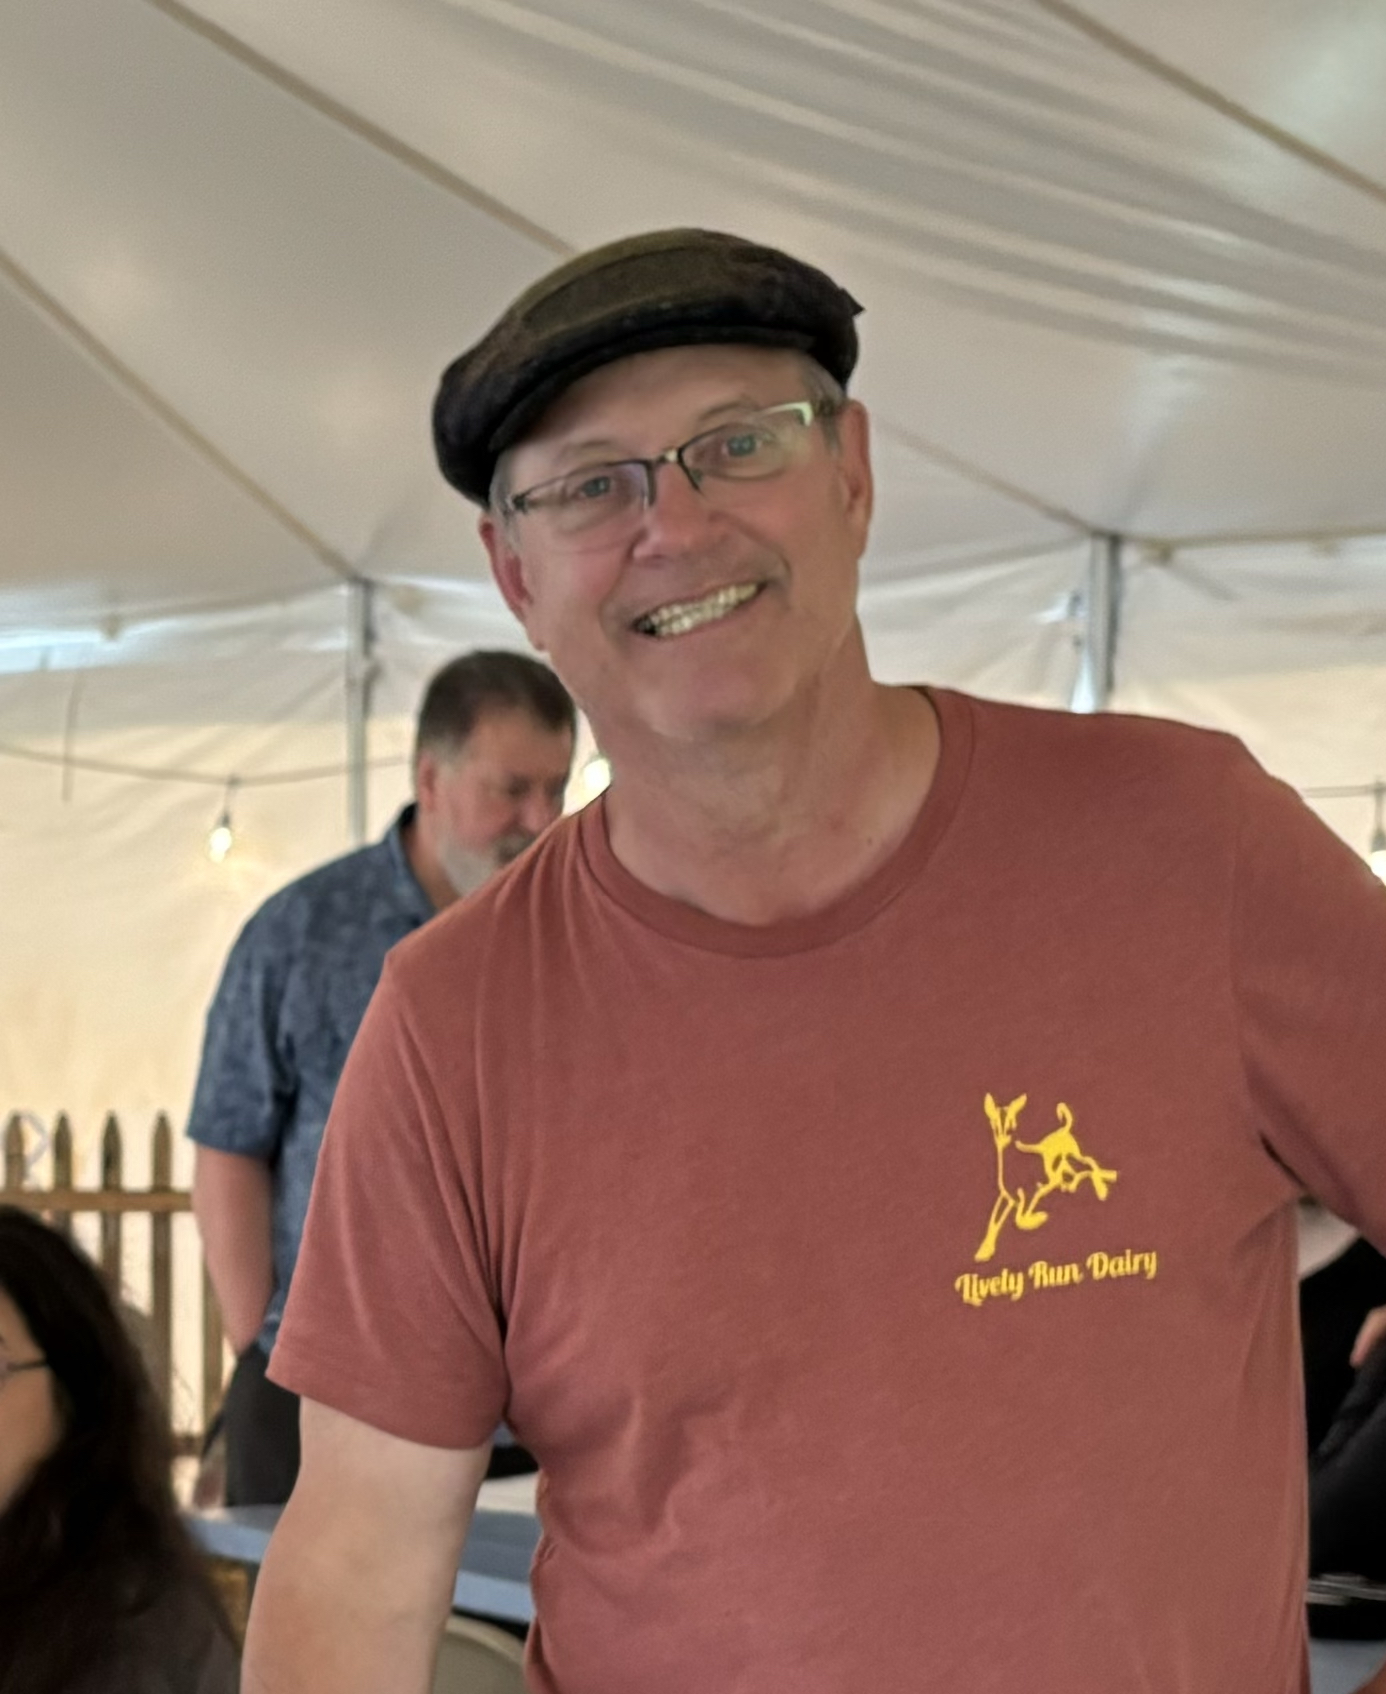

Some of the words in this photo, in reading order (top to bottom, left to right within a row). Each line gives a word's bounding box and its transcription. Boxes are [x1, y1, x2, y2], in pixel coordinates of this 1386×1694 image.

[954, 1267, 1025, 1307] Lively
[1028, 1260, 1084, 1290] Run
[1086, 1248, 1158, 1280] Dairy
